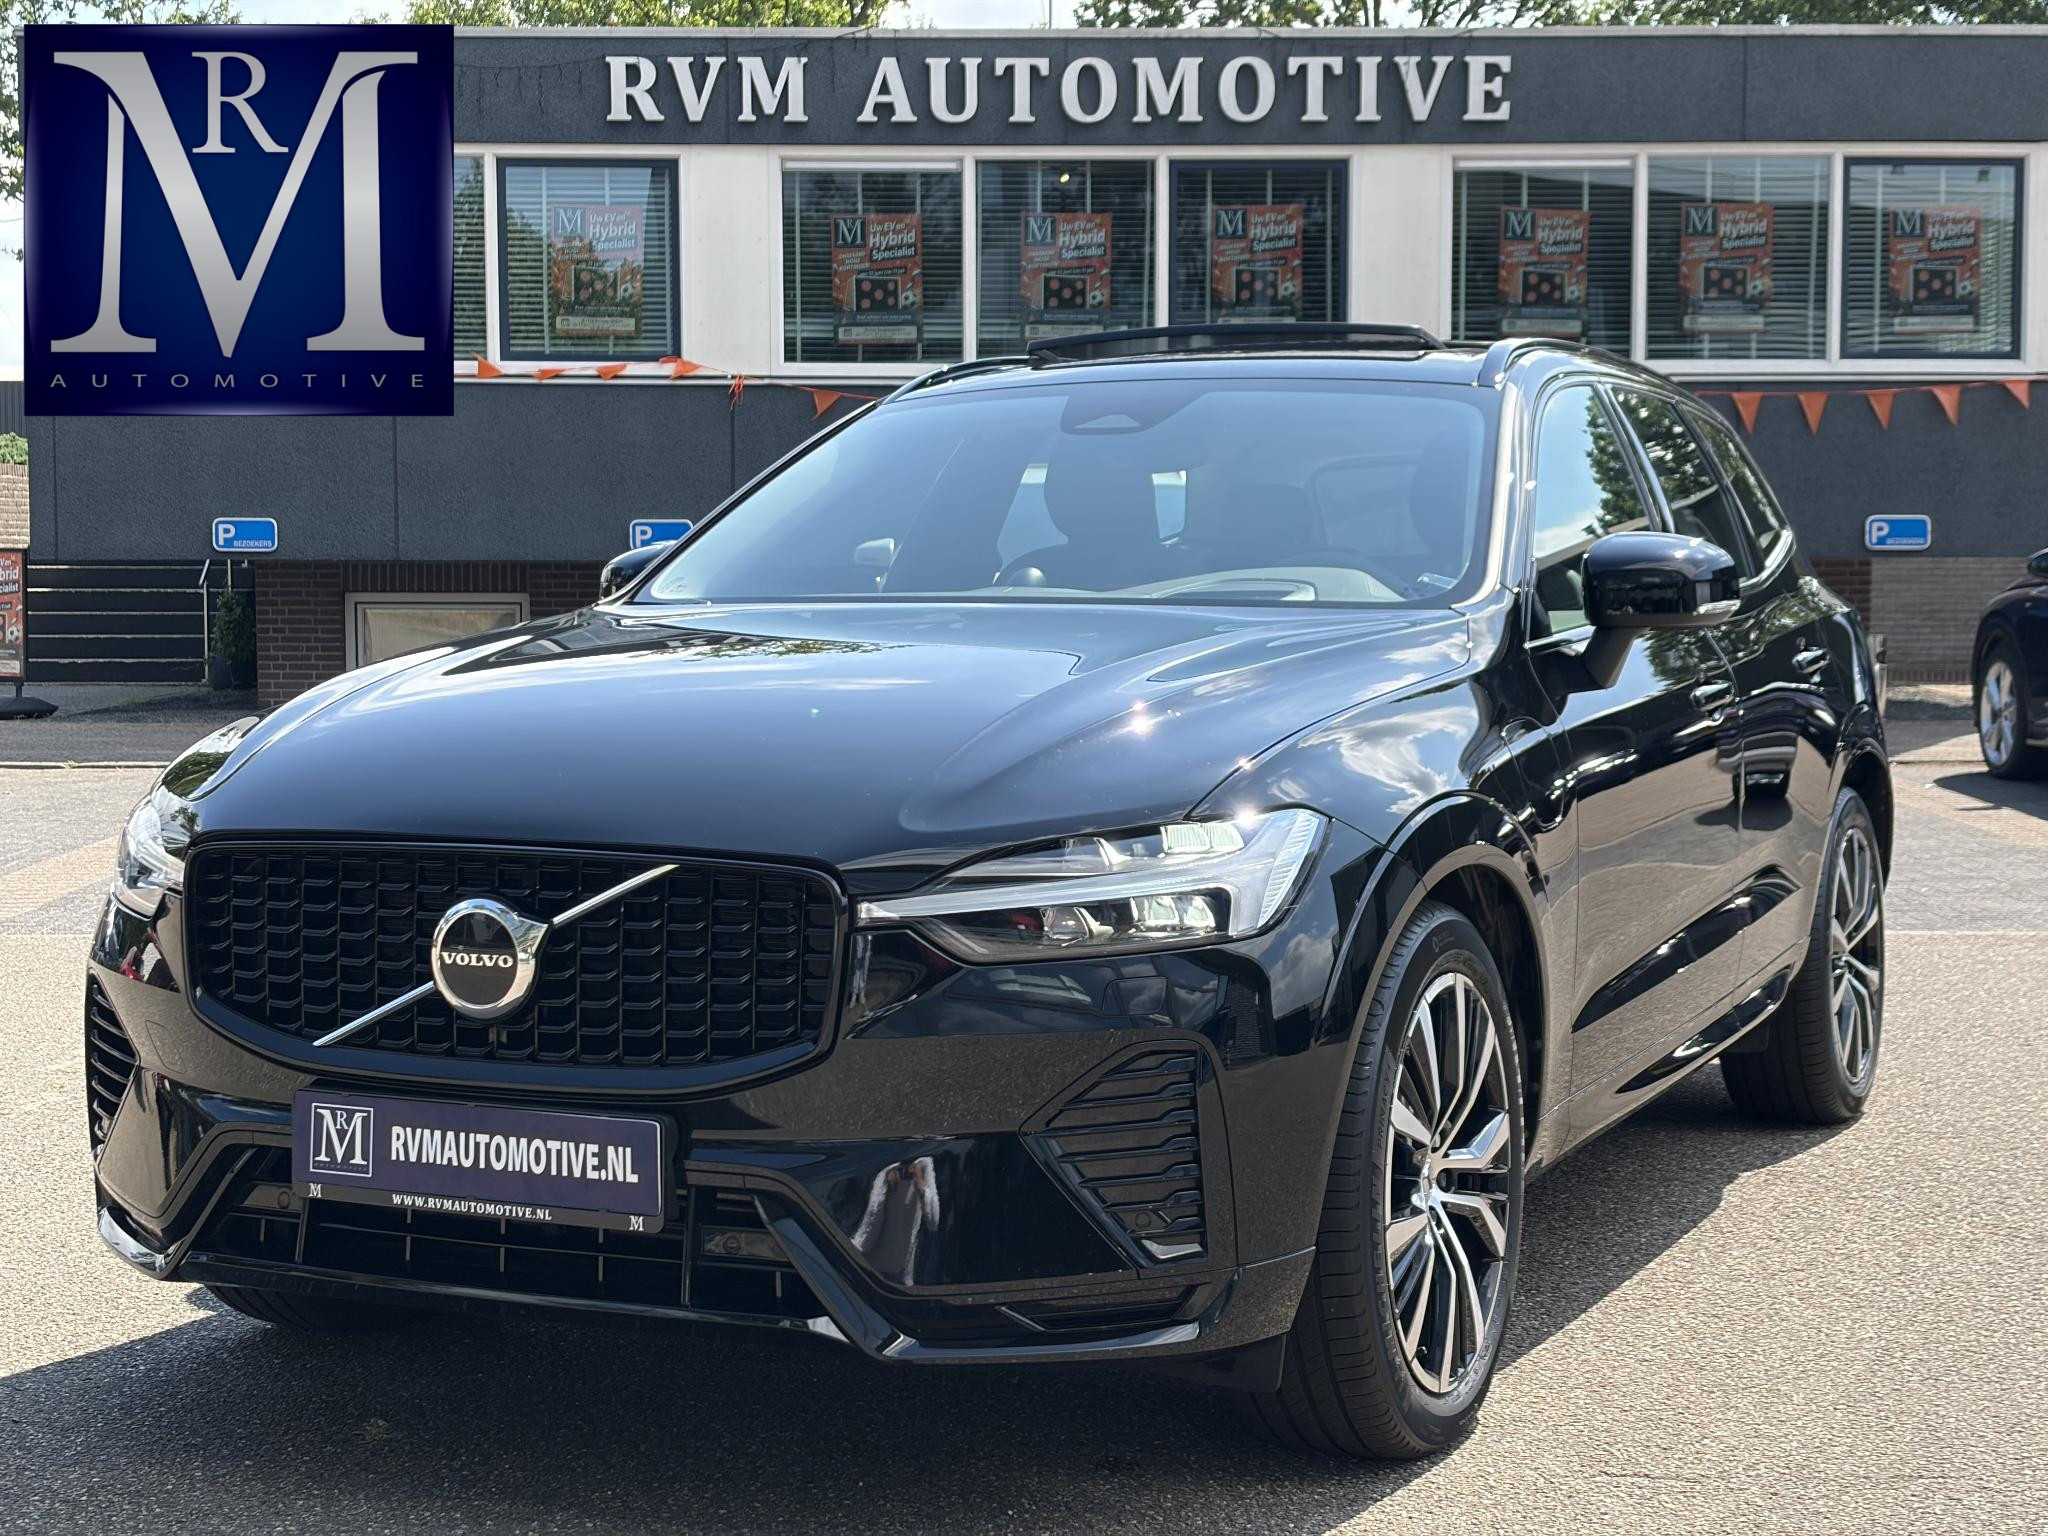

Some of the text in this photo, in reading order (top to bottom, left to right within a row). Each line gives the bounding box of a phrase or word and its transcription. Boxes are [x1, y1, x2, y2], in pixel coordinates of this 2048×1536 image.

[606, 55, 1513, 124] RVM AUTOMOTIVE
[590, 222, 636, 240] Hybrid
[870, 223, 883, 232] Uw
[884, 222, 896, 230] EV
[1251, 220, 1296, 240] Hybrid
[592, 239, 636, 251] Specialist
[869, 229, 916, 250] Hybrid
[1060, 228, 1106, 248] Hybrid
[1253, 237, 1296, 251] Specialist
[872, 246, 915, 260] Specialist
[1062, 246, 1105, 259] Specialist
[218, 524, 236, 545] P
[635, 526, 652, 547] P
[1872, 522, 1889, 544] P
[440, 952, 514, 968] VOLVO
[390, 1126, 639, 1184] RVMAUTOMOTIVE.NL
[392, 1193, 552, 1220] WWW.RVMAUTOMOTIVE.NL
